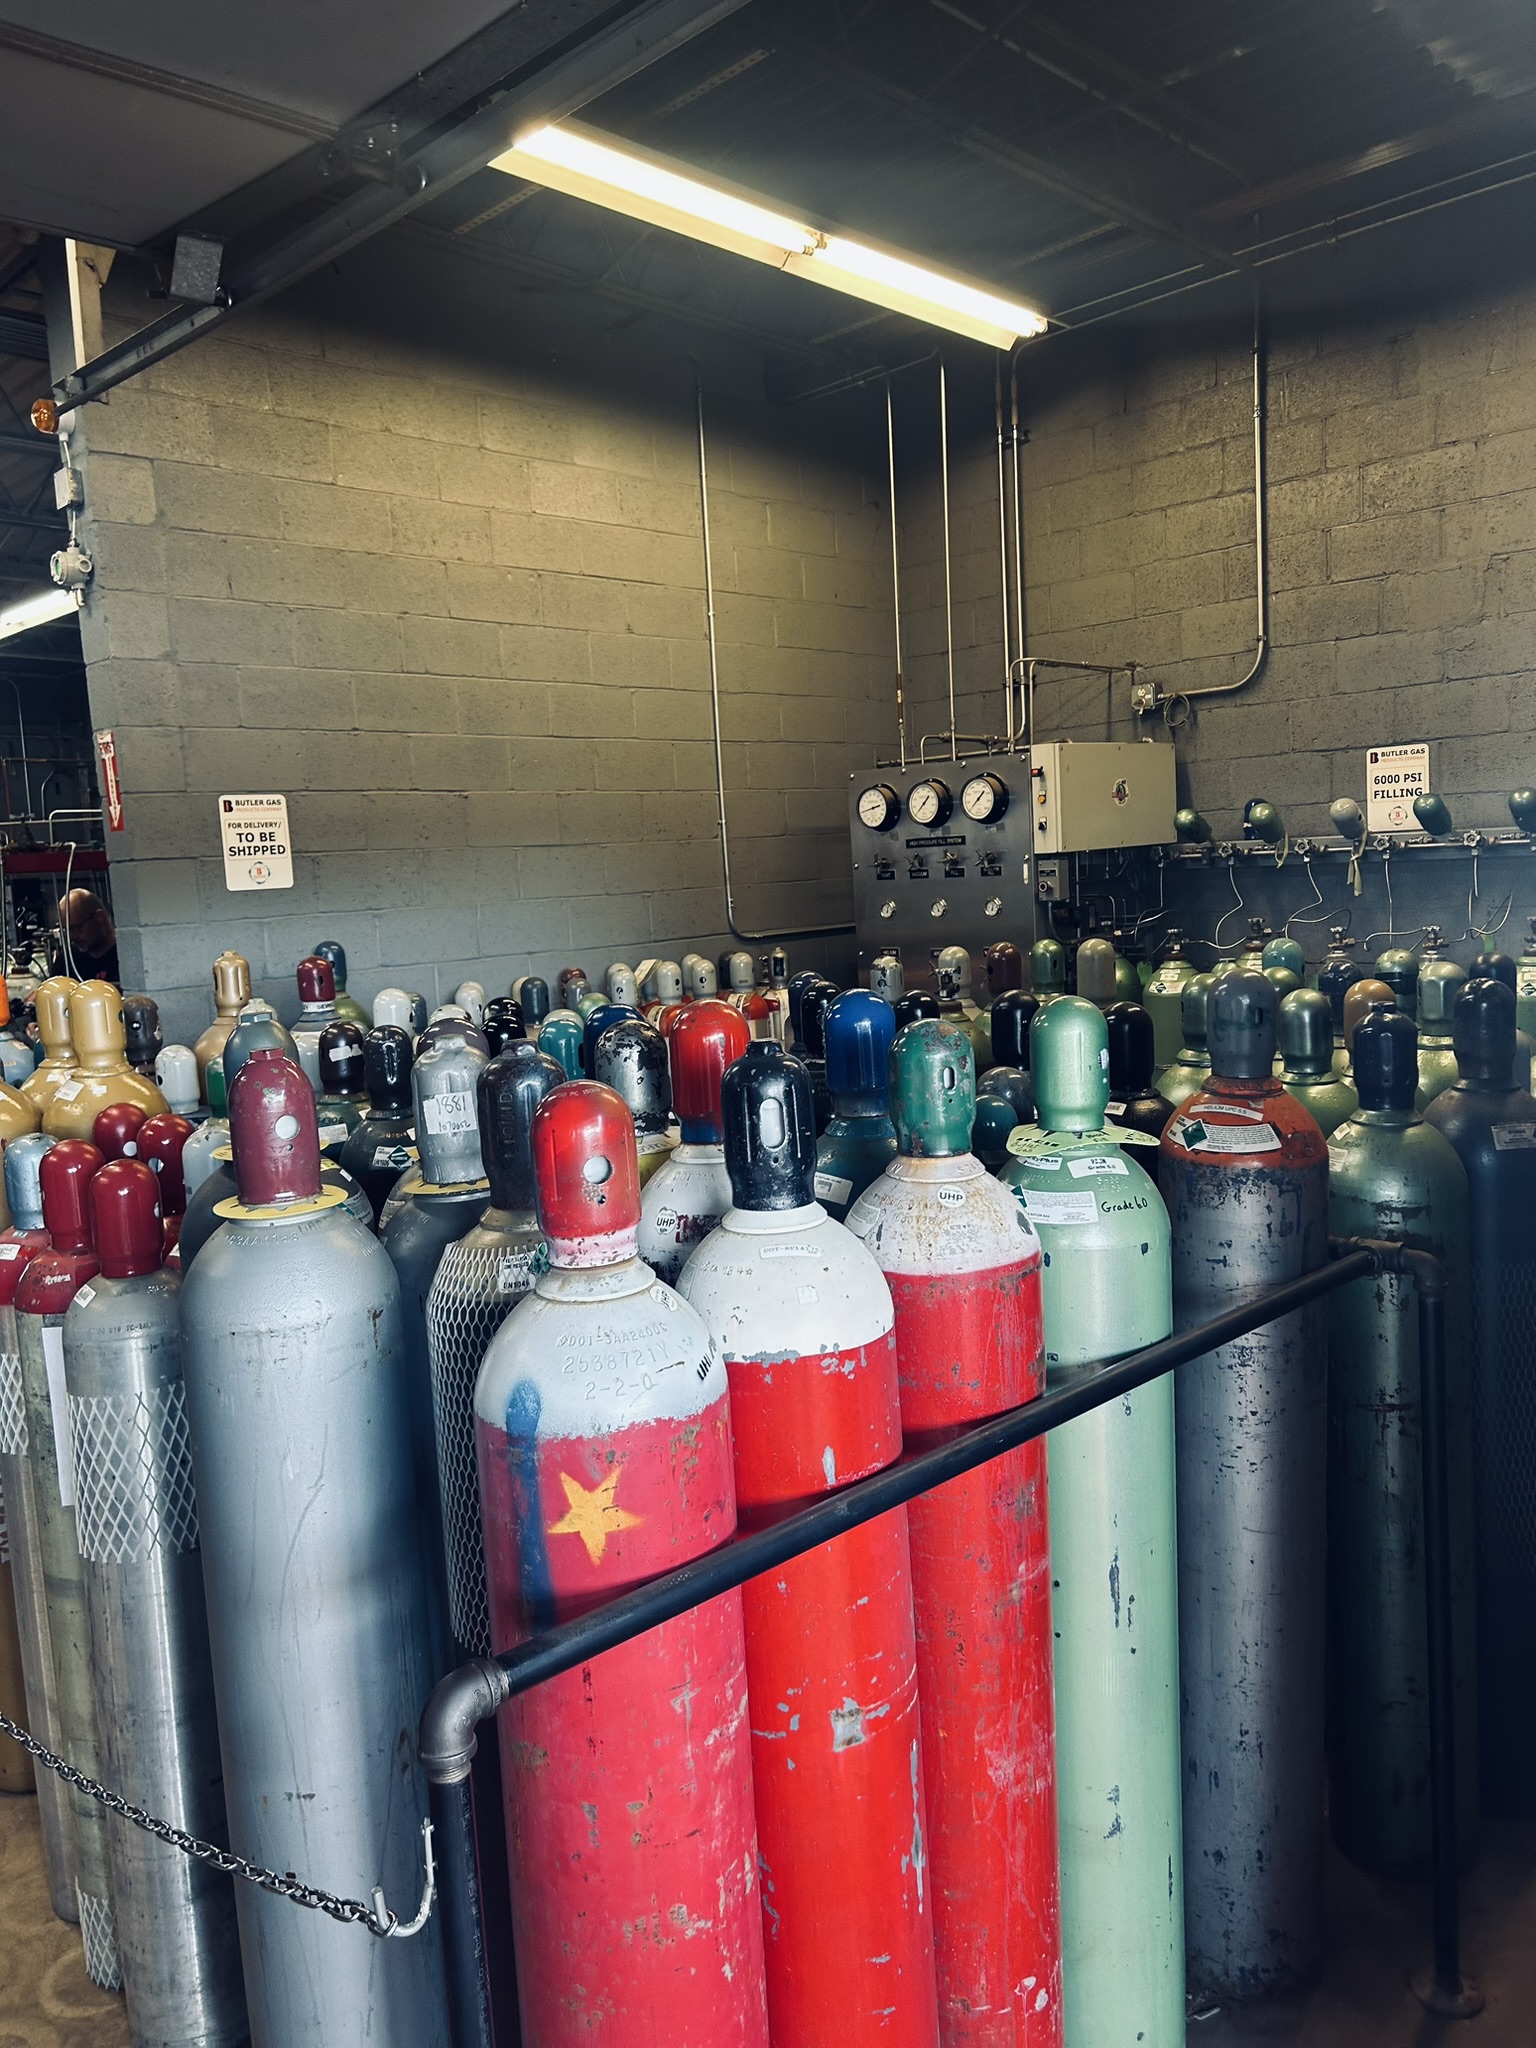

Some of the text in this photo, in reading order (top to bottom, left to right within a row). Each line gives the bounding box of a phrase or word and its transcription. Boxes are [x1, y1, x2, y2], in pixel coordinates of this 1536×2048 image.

[1374, 772, 1422, 785] 6000 PSI
[1374, 787, 1423, 799] FILLING
[236, 831, 276, 843] TO BE
[228, 844, 286, 856] SHIPPED
[436, 1094, 466, 1115] 1881
[939, 1191, 963, 1201] UHP
[1101, 1200, 1134, 1213] Grade
[656, 1217, 675, 1227] UHP
